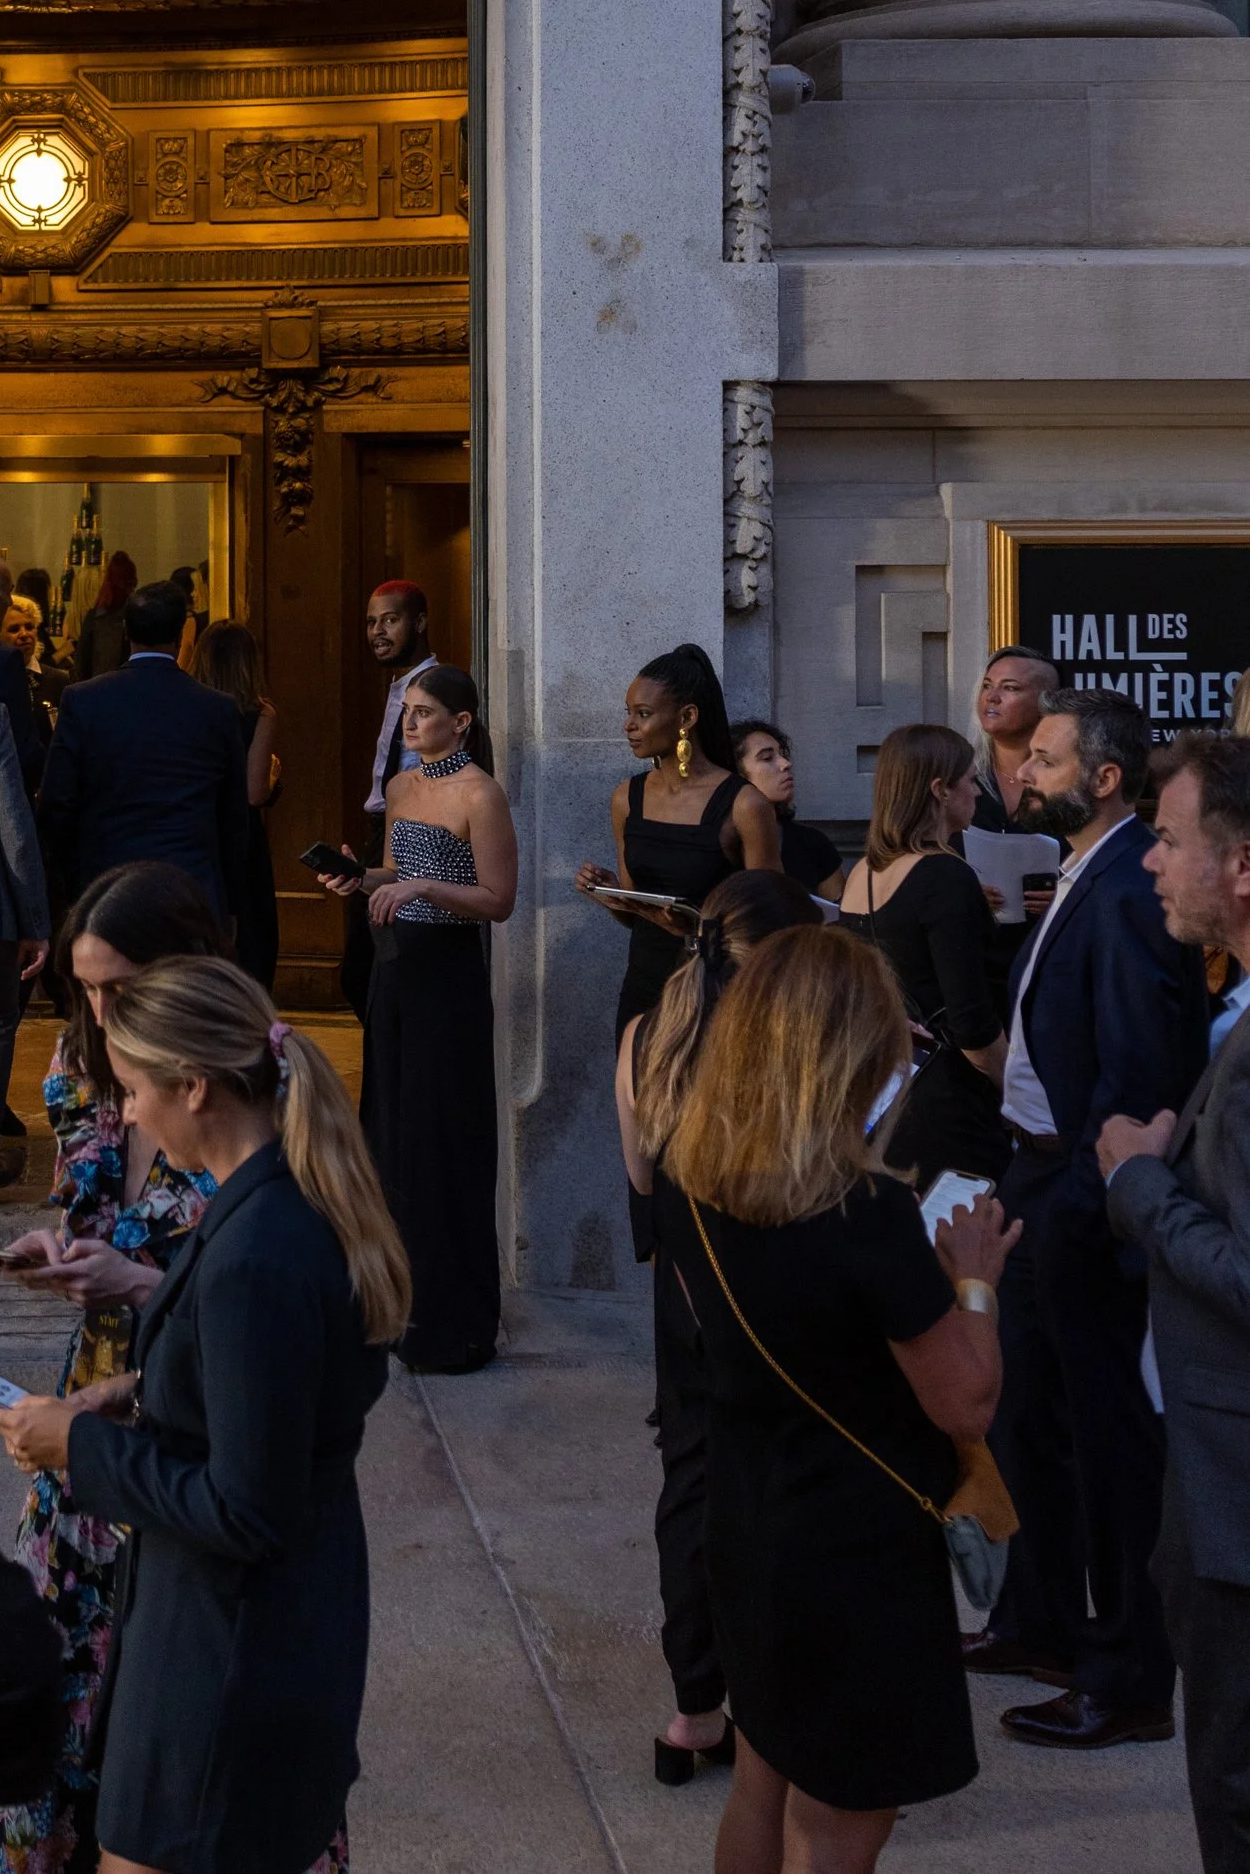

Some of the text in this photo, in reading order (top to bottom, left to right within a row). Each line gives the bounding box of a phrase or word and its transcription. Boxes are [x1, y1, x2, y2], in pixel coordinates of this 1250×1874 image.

[1052, 613, 1188, 660] HALL DES
[1074, 663, 1243, 719] IÈRES
[1151, 729, 1181, 742] EW
